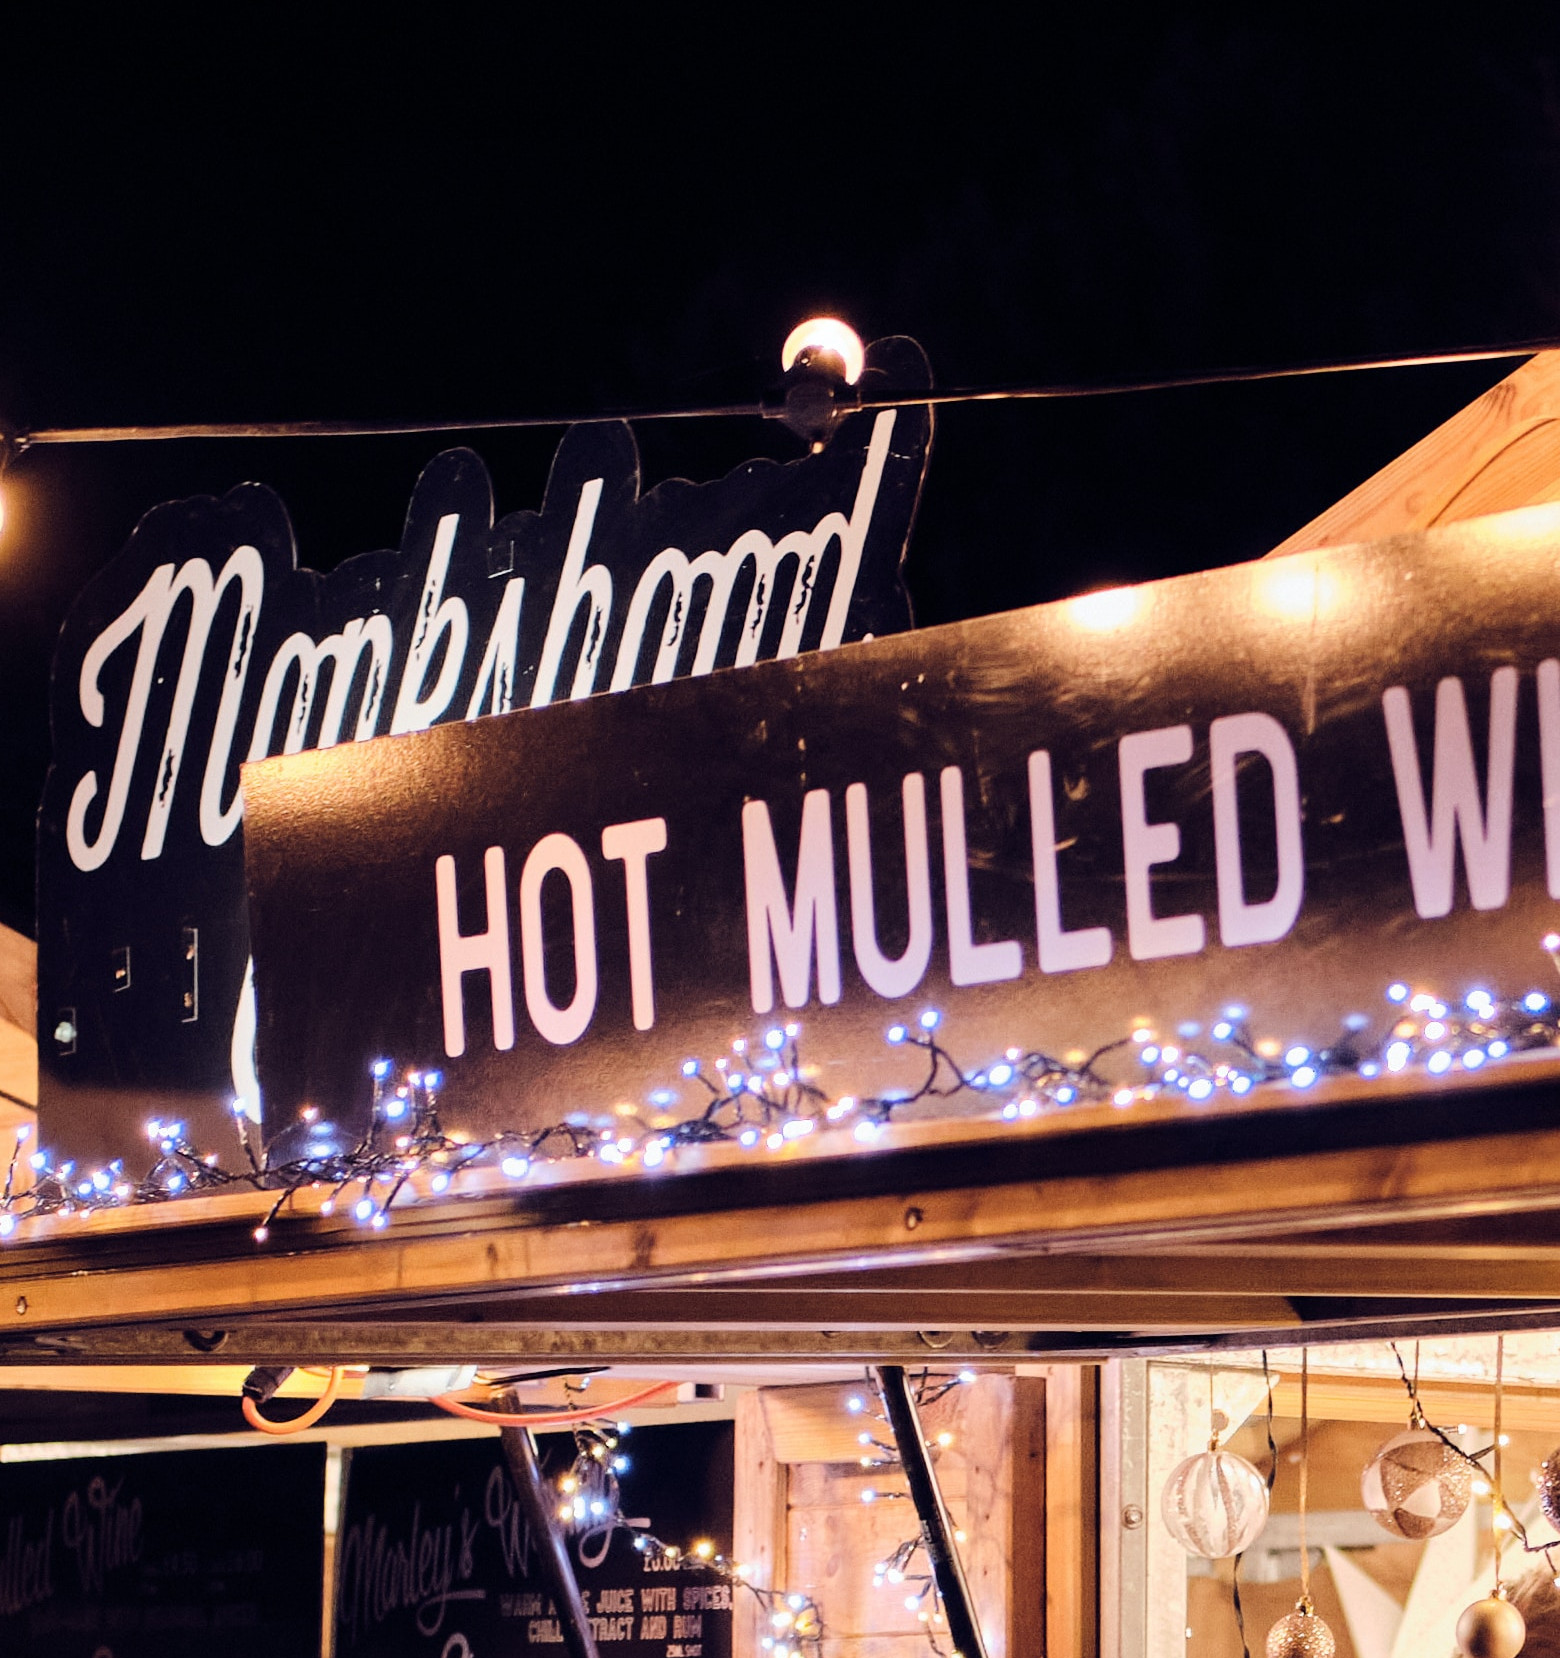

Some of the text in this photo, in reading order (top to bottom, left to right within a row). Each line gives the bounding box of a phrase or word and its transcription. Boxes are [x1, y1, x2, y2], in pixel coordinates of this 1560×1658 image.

[436, 816, 667, 1059] HOT
[742, 711, 1304, 1014] MULLED
[595, 1588, 636, 1614] JUICE
[640, 1586, 678, 1612] WITH
[640, 1615, 667, 1640] AND
[673, 1614, 704, 1639] RUM
